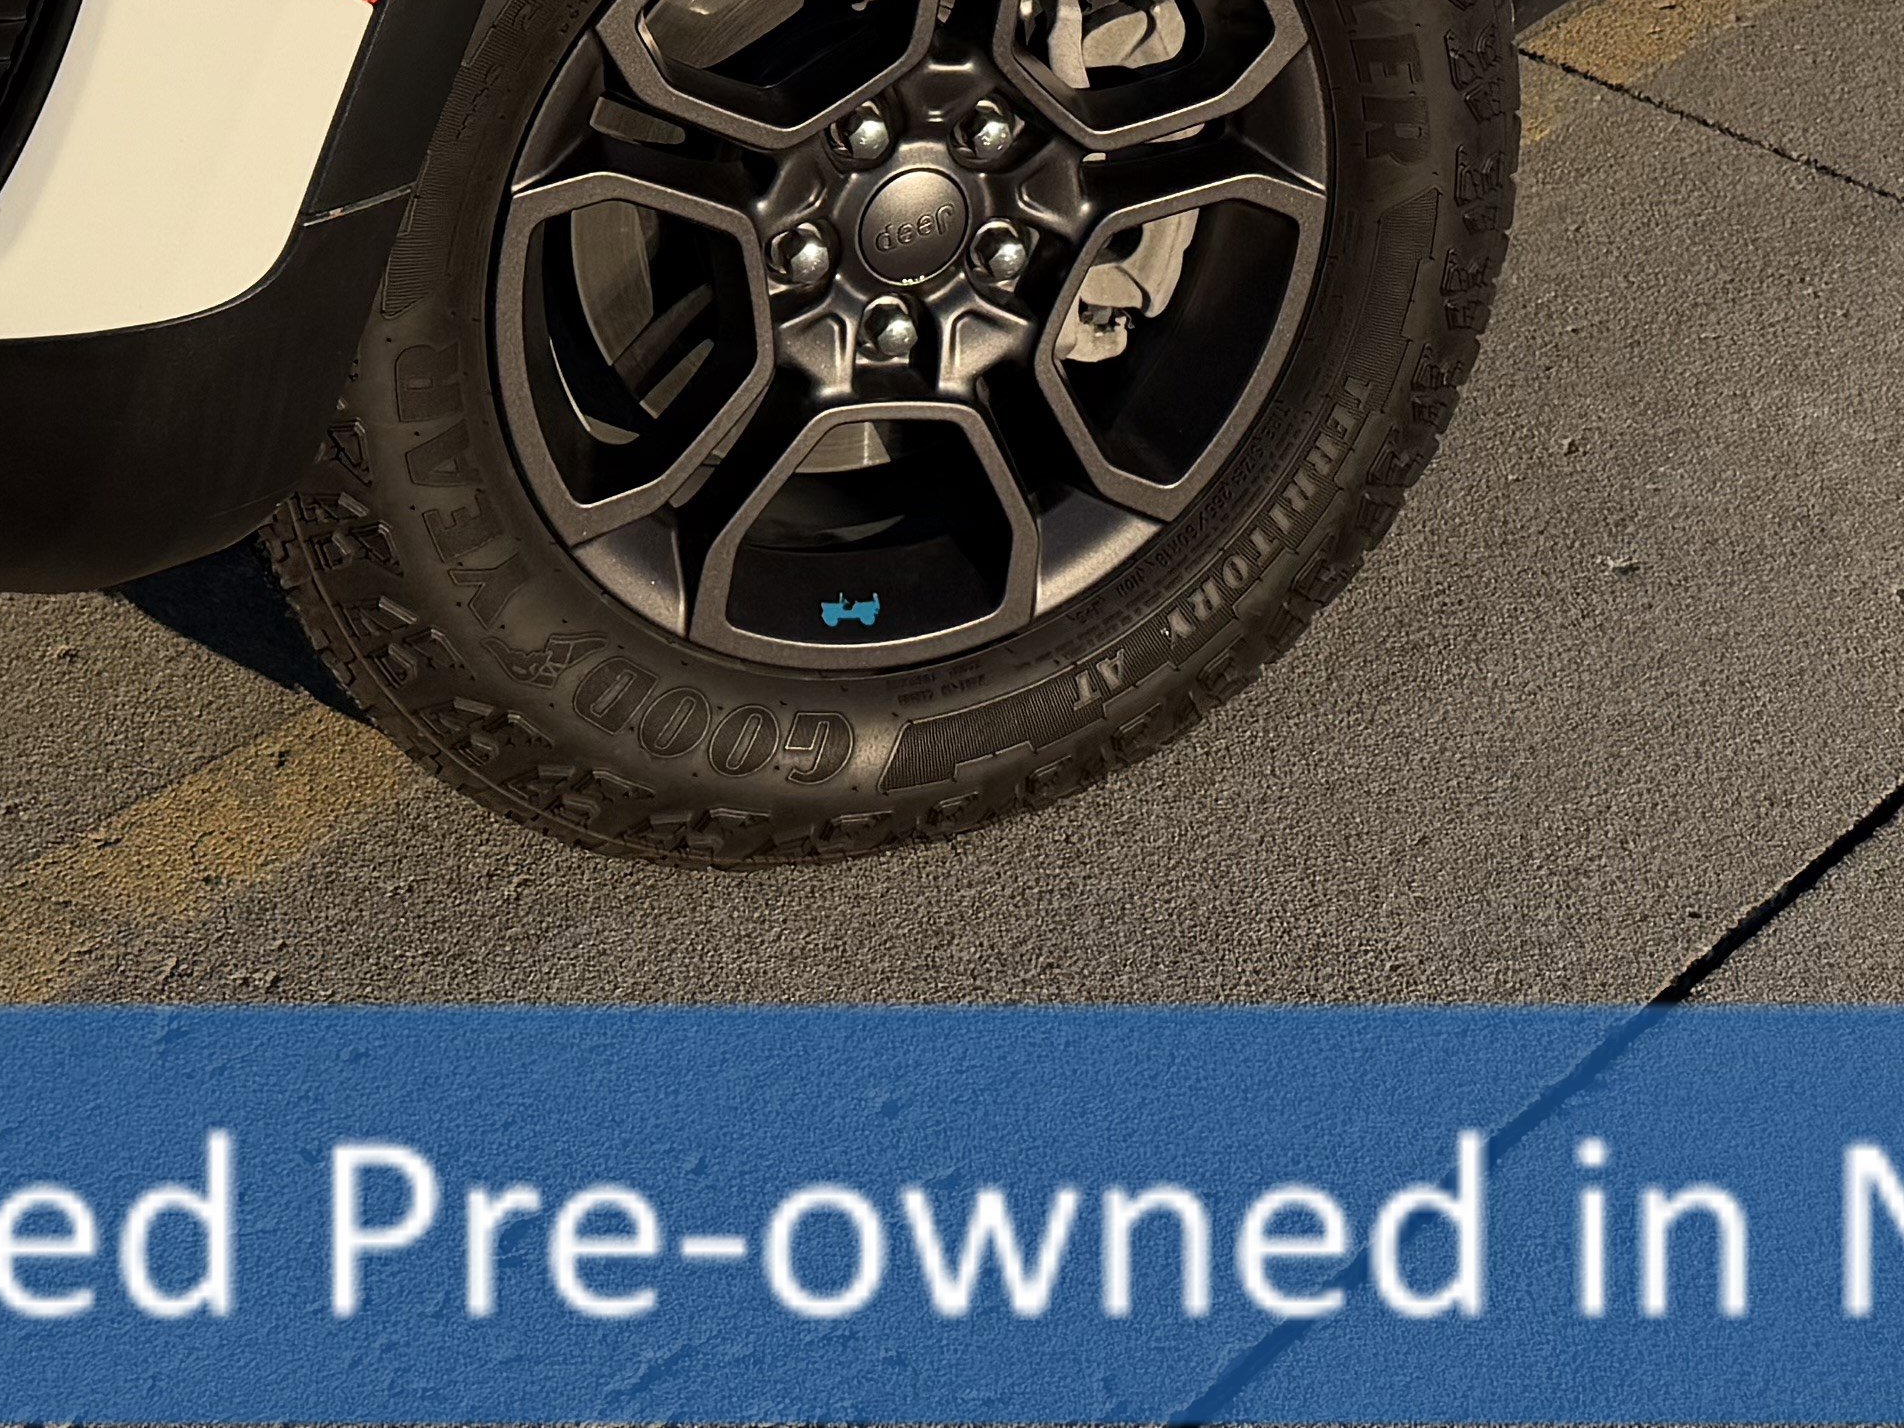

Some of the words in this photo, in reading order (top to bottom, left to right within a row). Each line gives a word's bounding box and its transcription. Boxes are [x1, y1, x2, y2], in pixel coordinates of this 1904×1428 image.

[875, 203, 955, 253] Jeep
[1162, 376, 1370, 648] TERRITORY
[1070, 647, 1127, 711] AT
